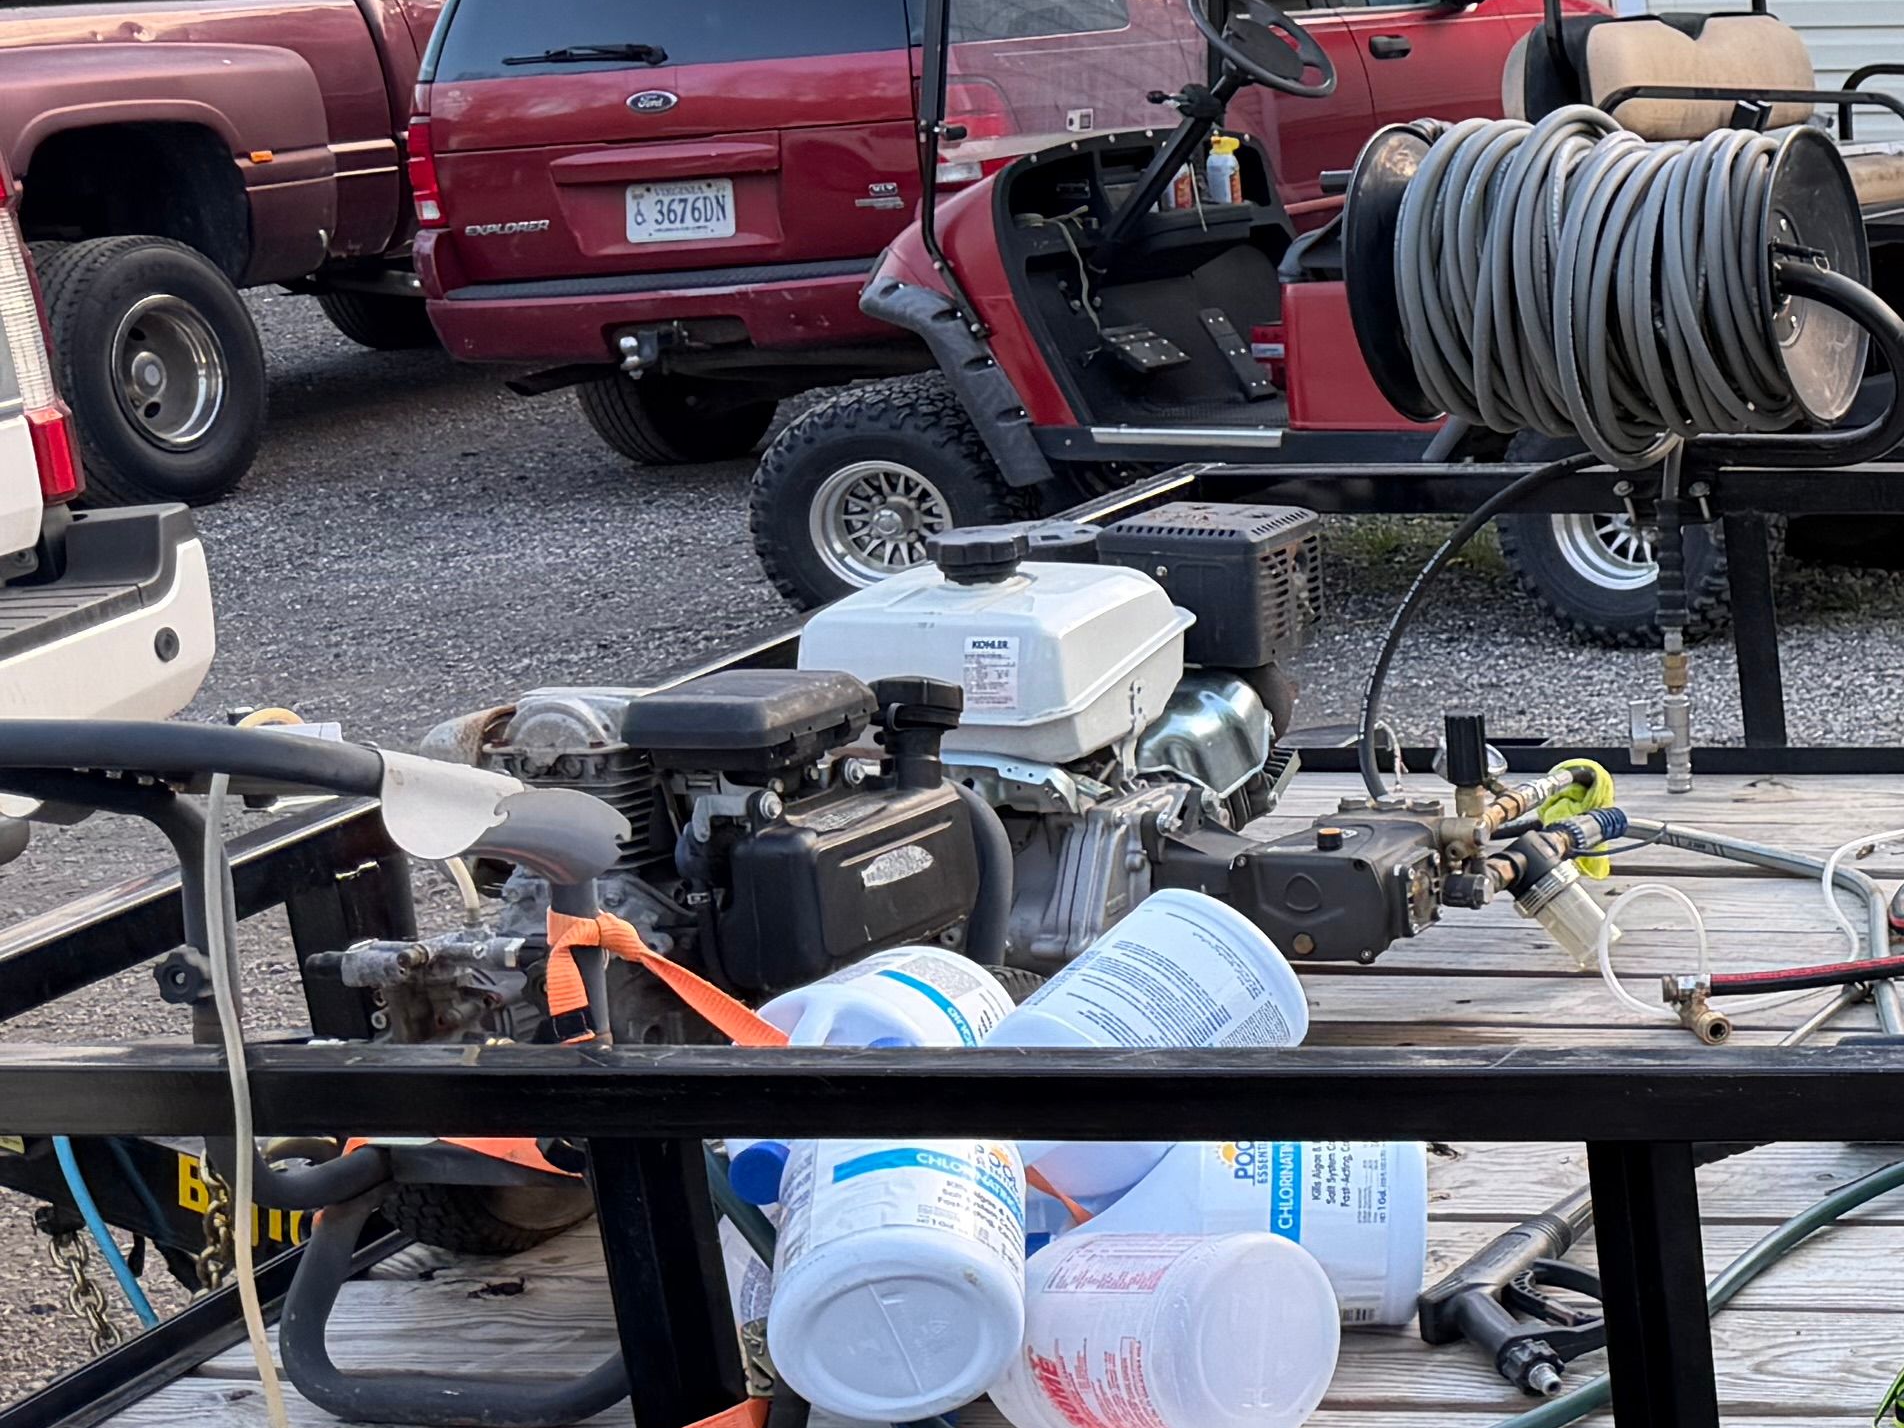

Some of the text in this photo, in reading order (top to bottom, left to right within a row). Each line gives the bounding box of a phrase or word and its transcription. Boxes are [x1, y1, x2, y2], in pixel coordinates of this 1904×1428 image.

[637, 96, 664, 108] Ford
[654, 185, 705, 197] VIRGINIA
[654, 194, 728, 226] 3676DN
[465, 219, 550, 237] EXPLORER
[971, 640, 1009, 650] KOHLER
[1326, 1152, 1339, 1183] System
[1311, 1181, 1322, 1201] Kills
[1326, 1185, 1337, 1205] Salt
